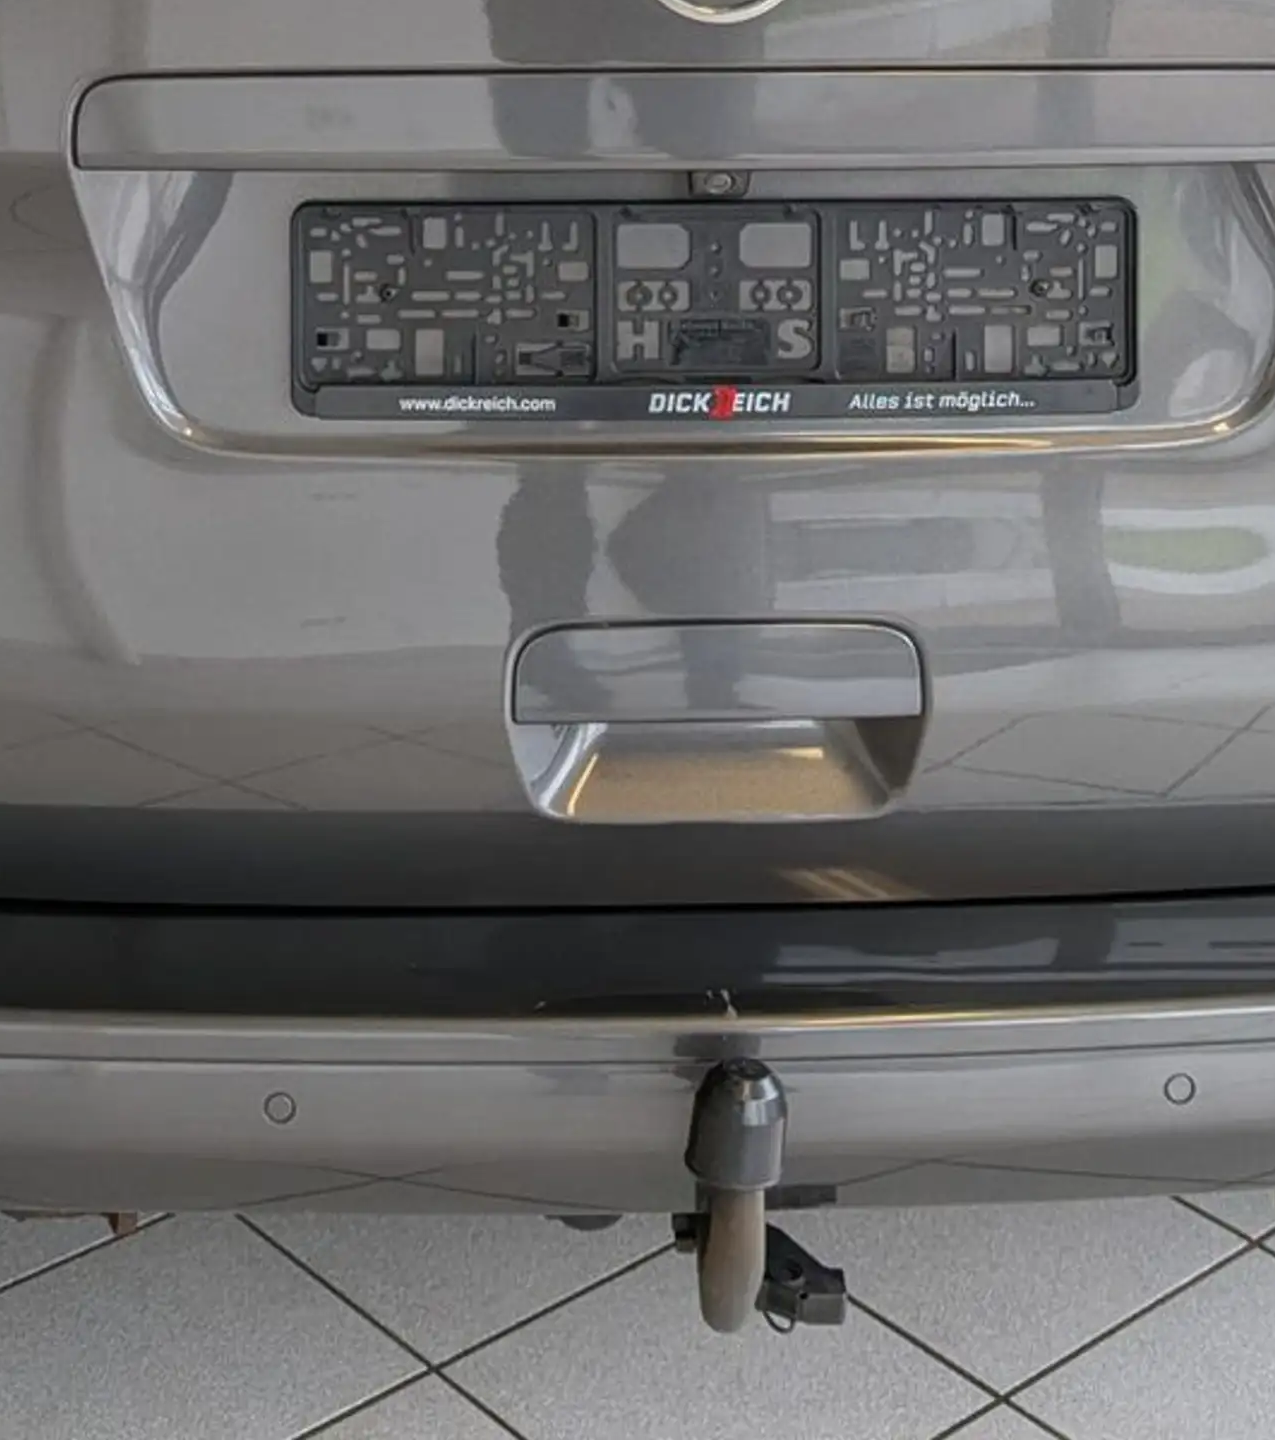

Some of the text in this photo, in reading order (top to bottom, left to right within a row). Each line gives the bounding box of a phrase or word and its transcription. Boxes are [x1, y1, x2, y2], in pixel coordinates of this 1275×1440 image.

[399, 396, 556, 413] www.dickreich.com
[849, 393, 899, 410] Alles
[904, 392, 934, 409] ist
